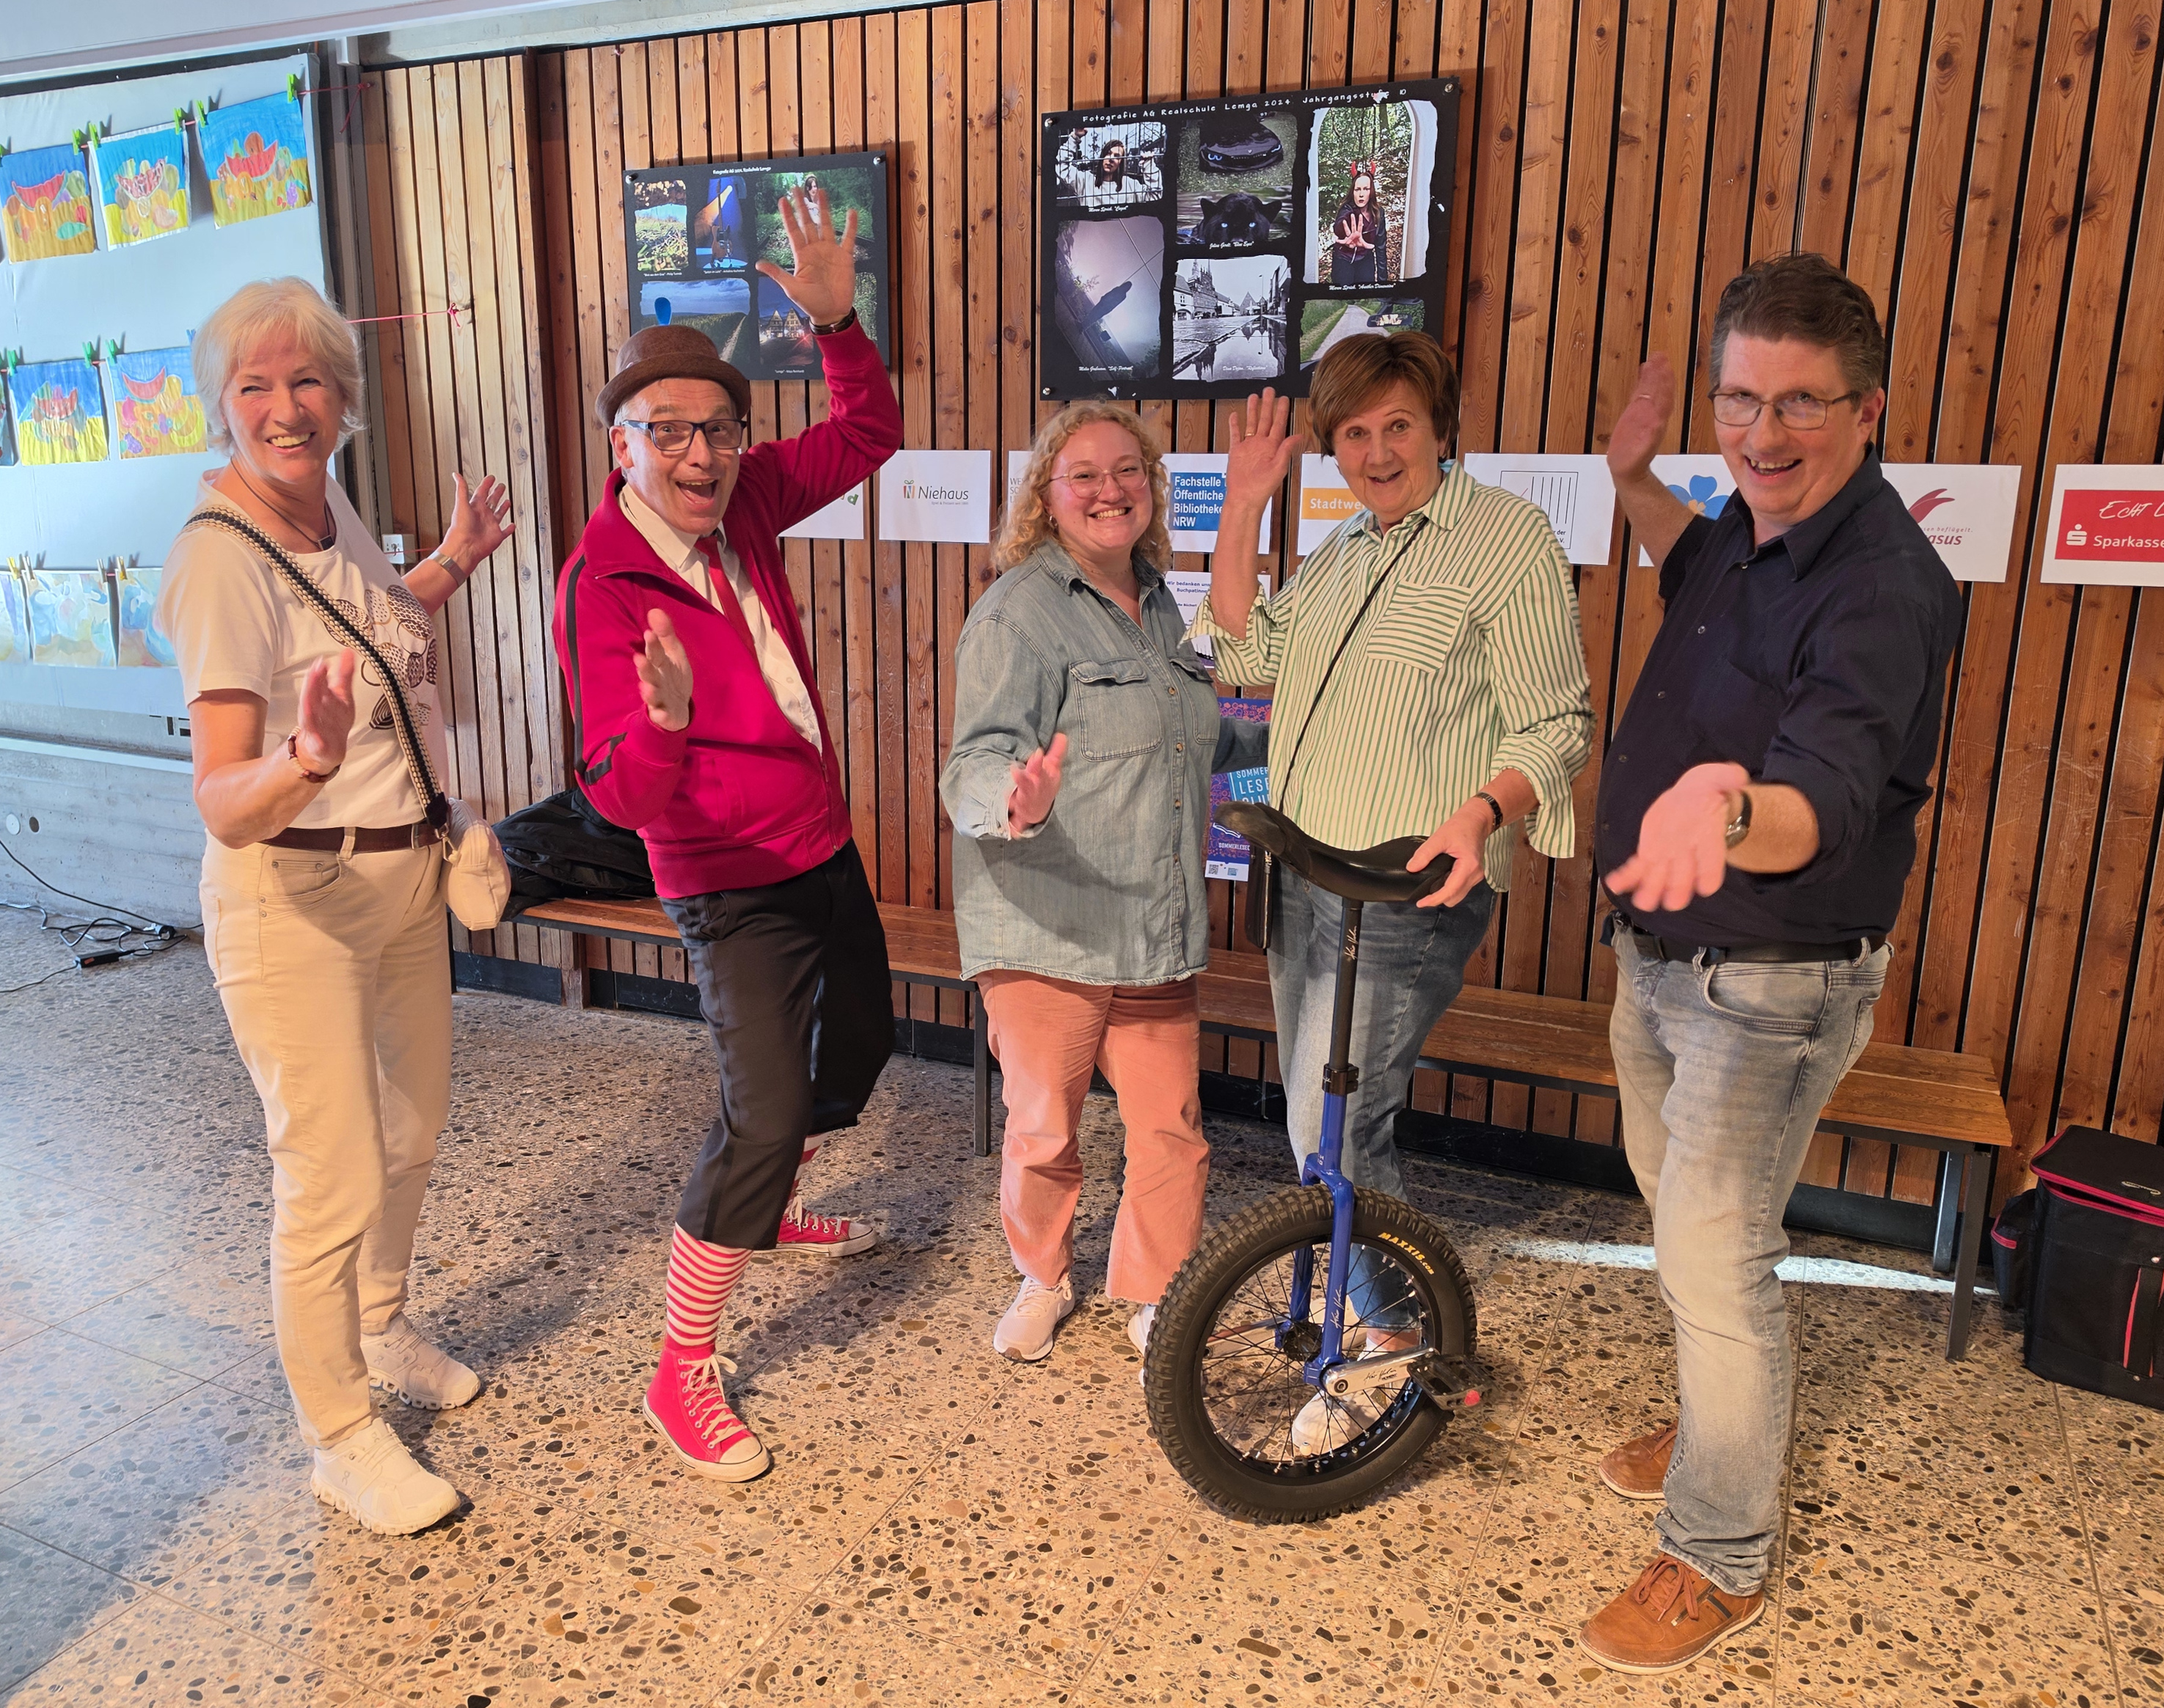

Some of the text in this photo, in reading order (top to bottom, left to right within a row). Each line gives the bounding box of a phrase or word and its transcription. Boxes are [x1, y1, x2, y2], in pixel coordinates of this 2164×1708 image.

[1082, 111, 1137, 122] Fotografie
[1161, 105, 1216, 116] Realschule
[1265, 99, 1291, 107] 2024
[1174, 476, 1221, 487] Fachstelle
[918, 485, 969, 500] Niehaus
[1174, 488, 1224, 500] Öffentliche
[1173, 516, 1196, 527] NRW
[2093, 535, 2164, 549] Sparkasse
